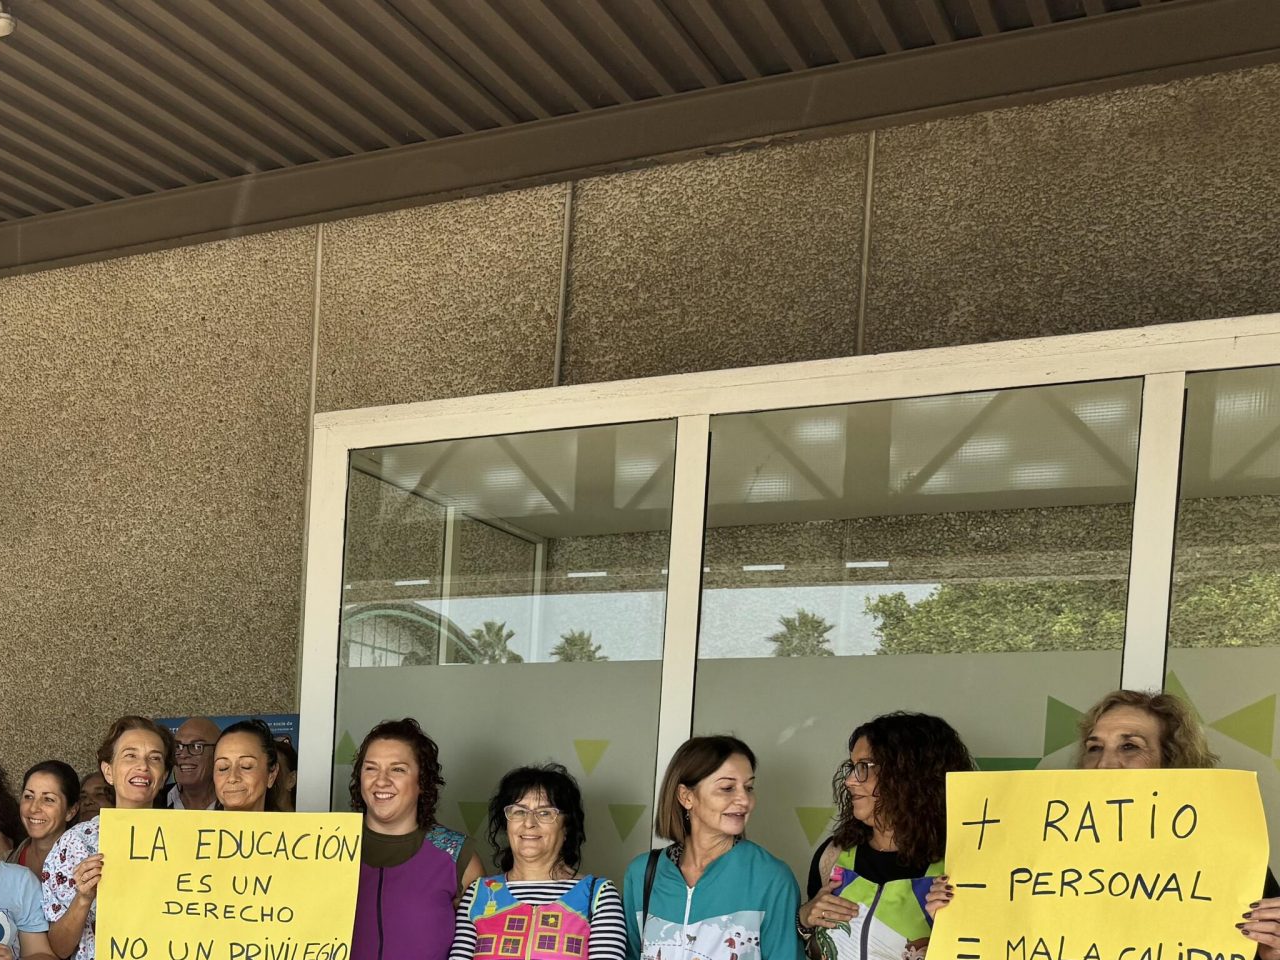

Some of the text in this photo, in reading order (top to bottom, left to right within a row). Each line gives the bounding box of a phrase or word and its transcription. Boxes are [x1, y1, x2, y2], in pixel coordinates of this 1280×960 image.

[1043, 791, 1197, 843] RATIO
[129, 825, 360, 861] LA EDUCACIÓN
[177, 873, 272, 895] ES UN
[1010, 867, 1212, 902] PERSONAL
[161, 901, 294, 922] DERECHO
[110, 937, 148, 960] NO
